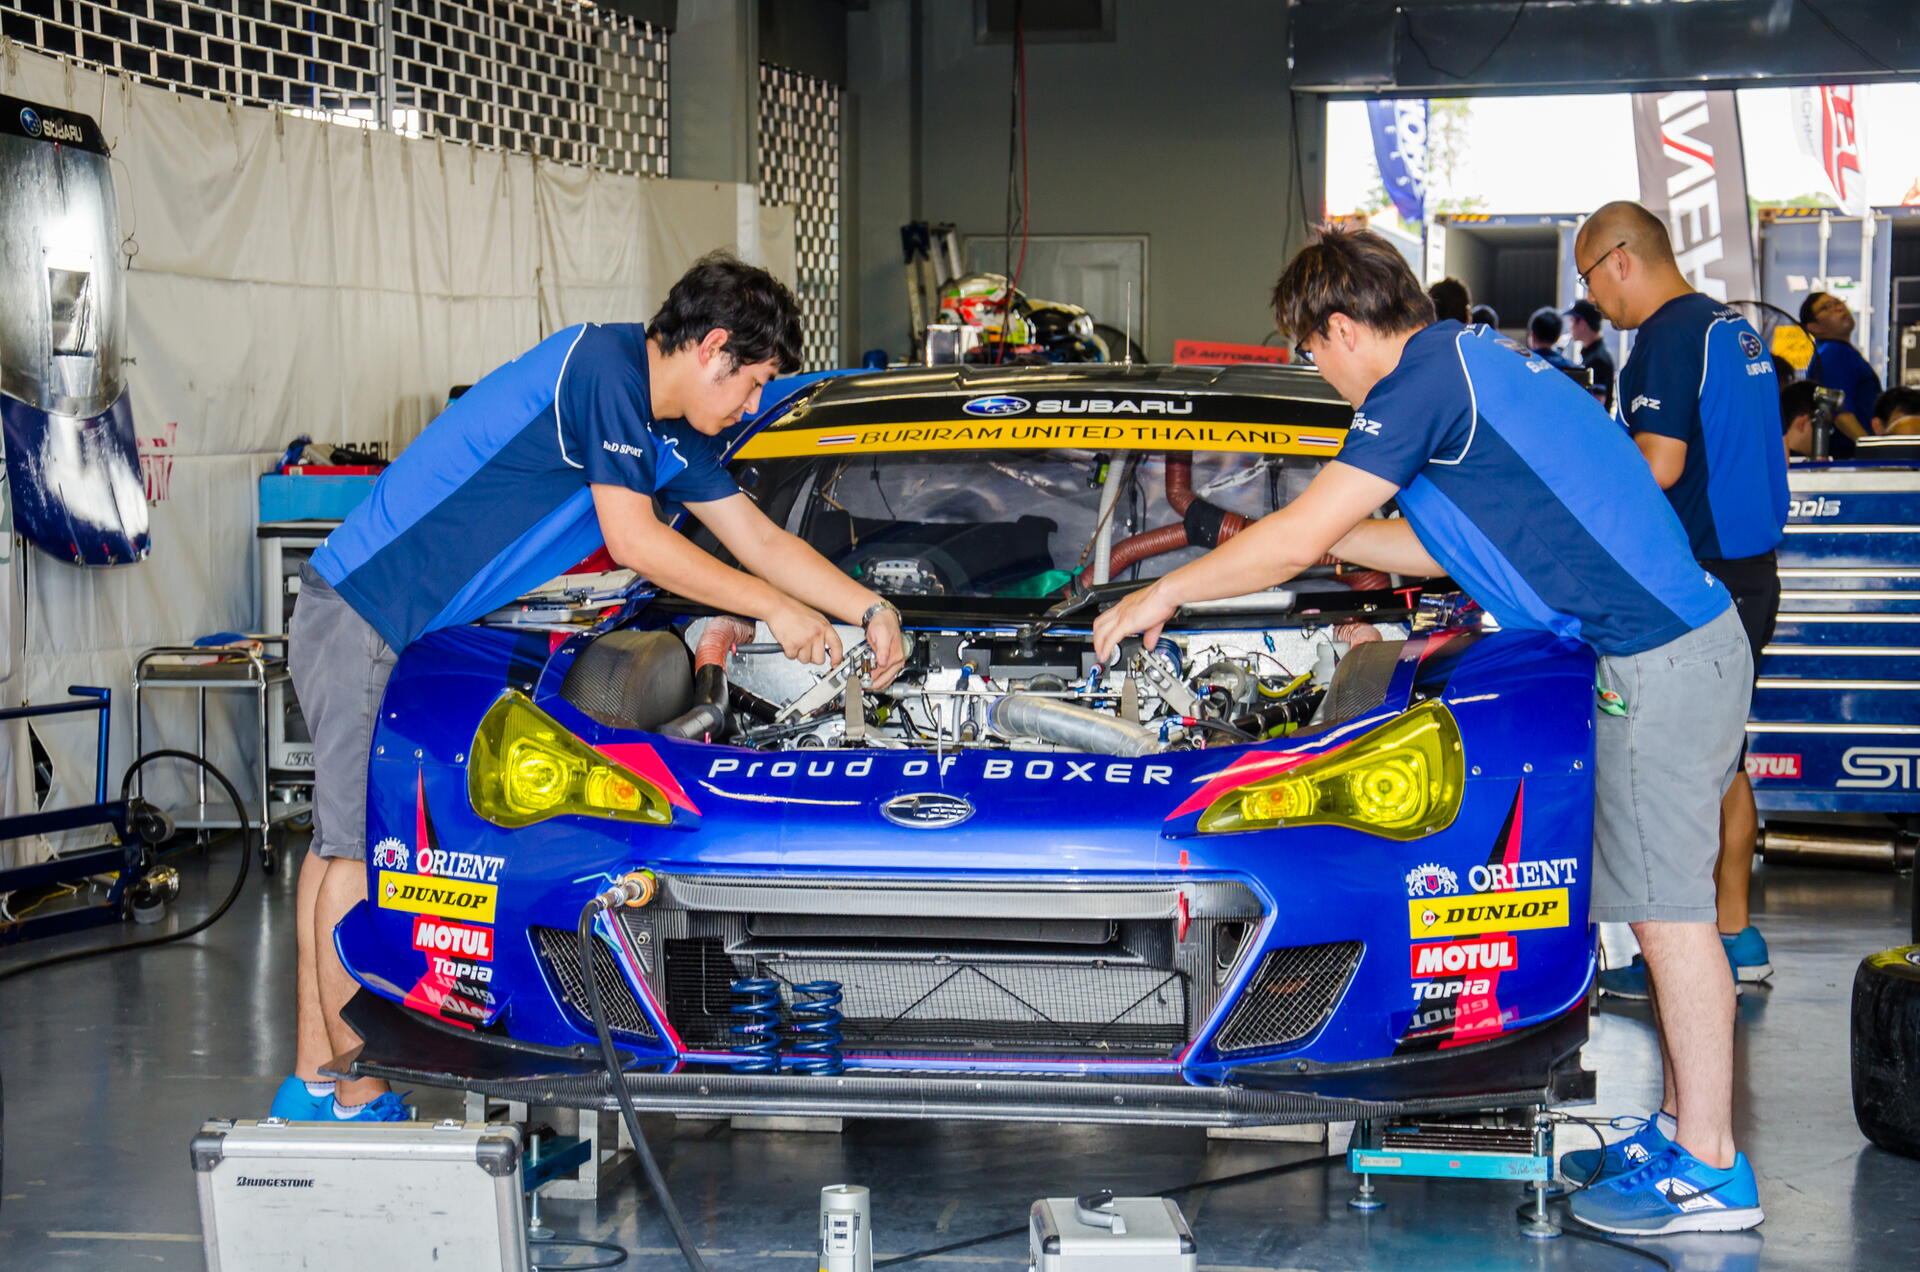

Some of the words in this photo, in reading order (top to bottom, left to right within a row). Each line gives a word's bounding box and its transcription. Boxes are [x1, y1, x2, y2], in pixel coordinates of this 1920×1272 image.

[1035, 399, 1193, 415] SUBARU
[860, 426, 1003, 445] BURIRAM
[1011, 425, 1124, 440] UNITED
[1131, 427, 1291, 445] THAILAND
[620, 443, 643, 458] SPORT
[708, 757, 873, 778] Proud
[902, 756, 957, 777] of
[983, 759, 1173, 785] BOXER
[416, 847, 505, 882] ORIENT
[1468, 857, 1578, 892] ORIENT
[400, 885, 488, 909] DUNLOP
[1444, 901, 1559, 924] DUNLOP
[415, 922, 490, 957] MOTUL
[1416, 941, 1513, 974] MOTUL
[236, 1176, 316, 1188] BRIDGESTONE
